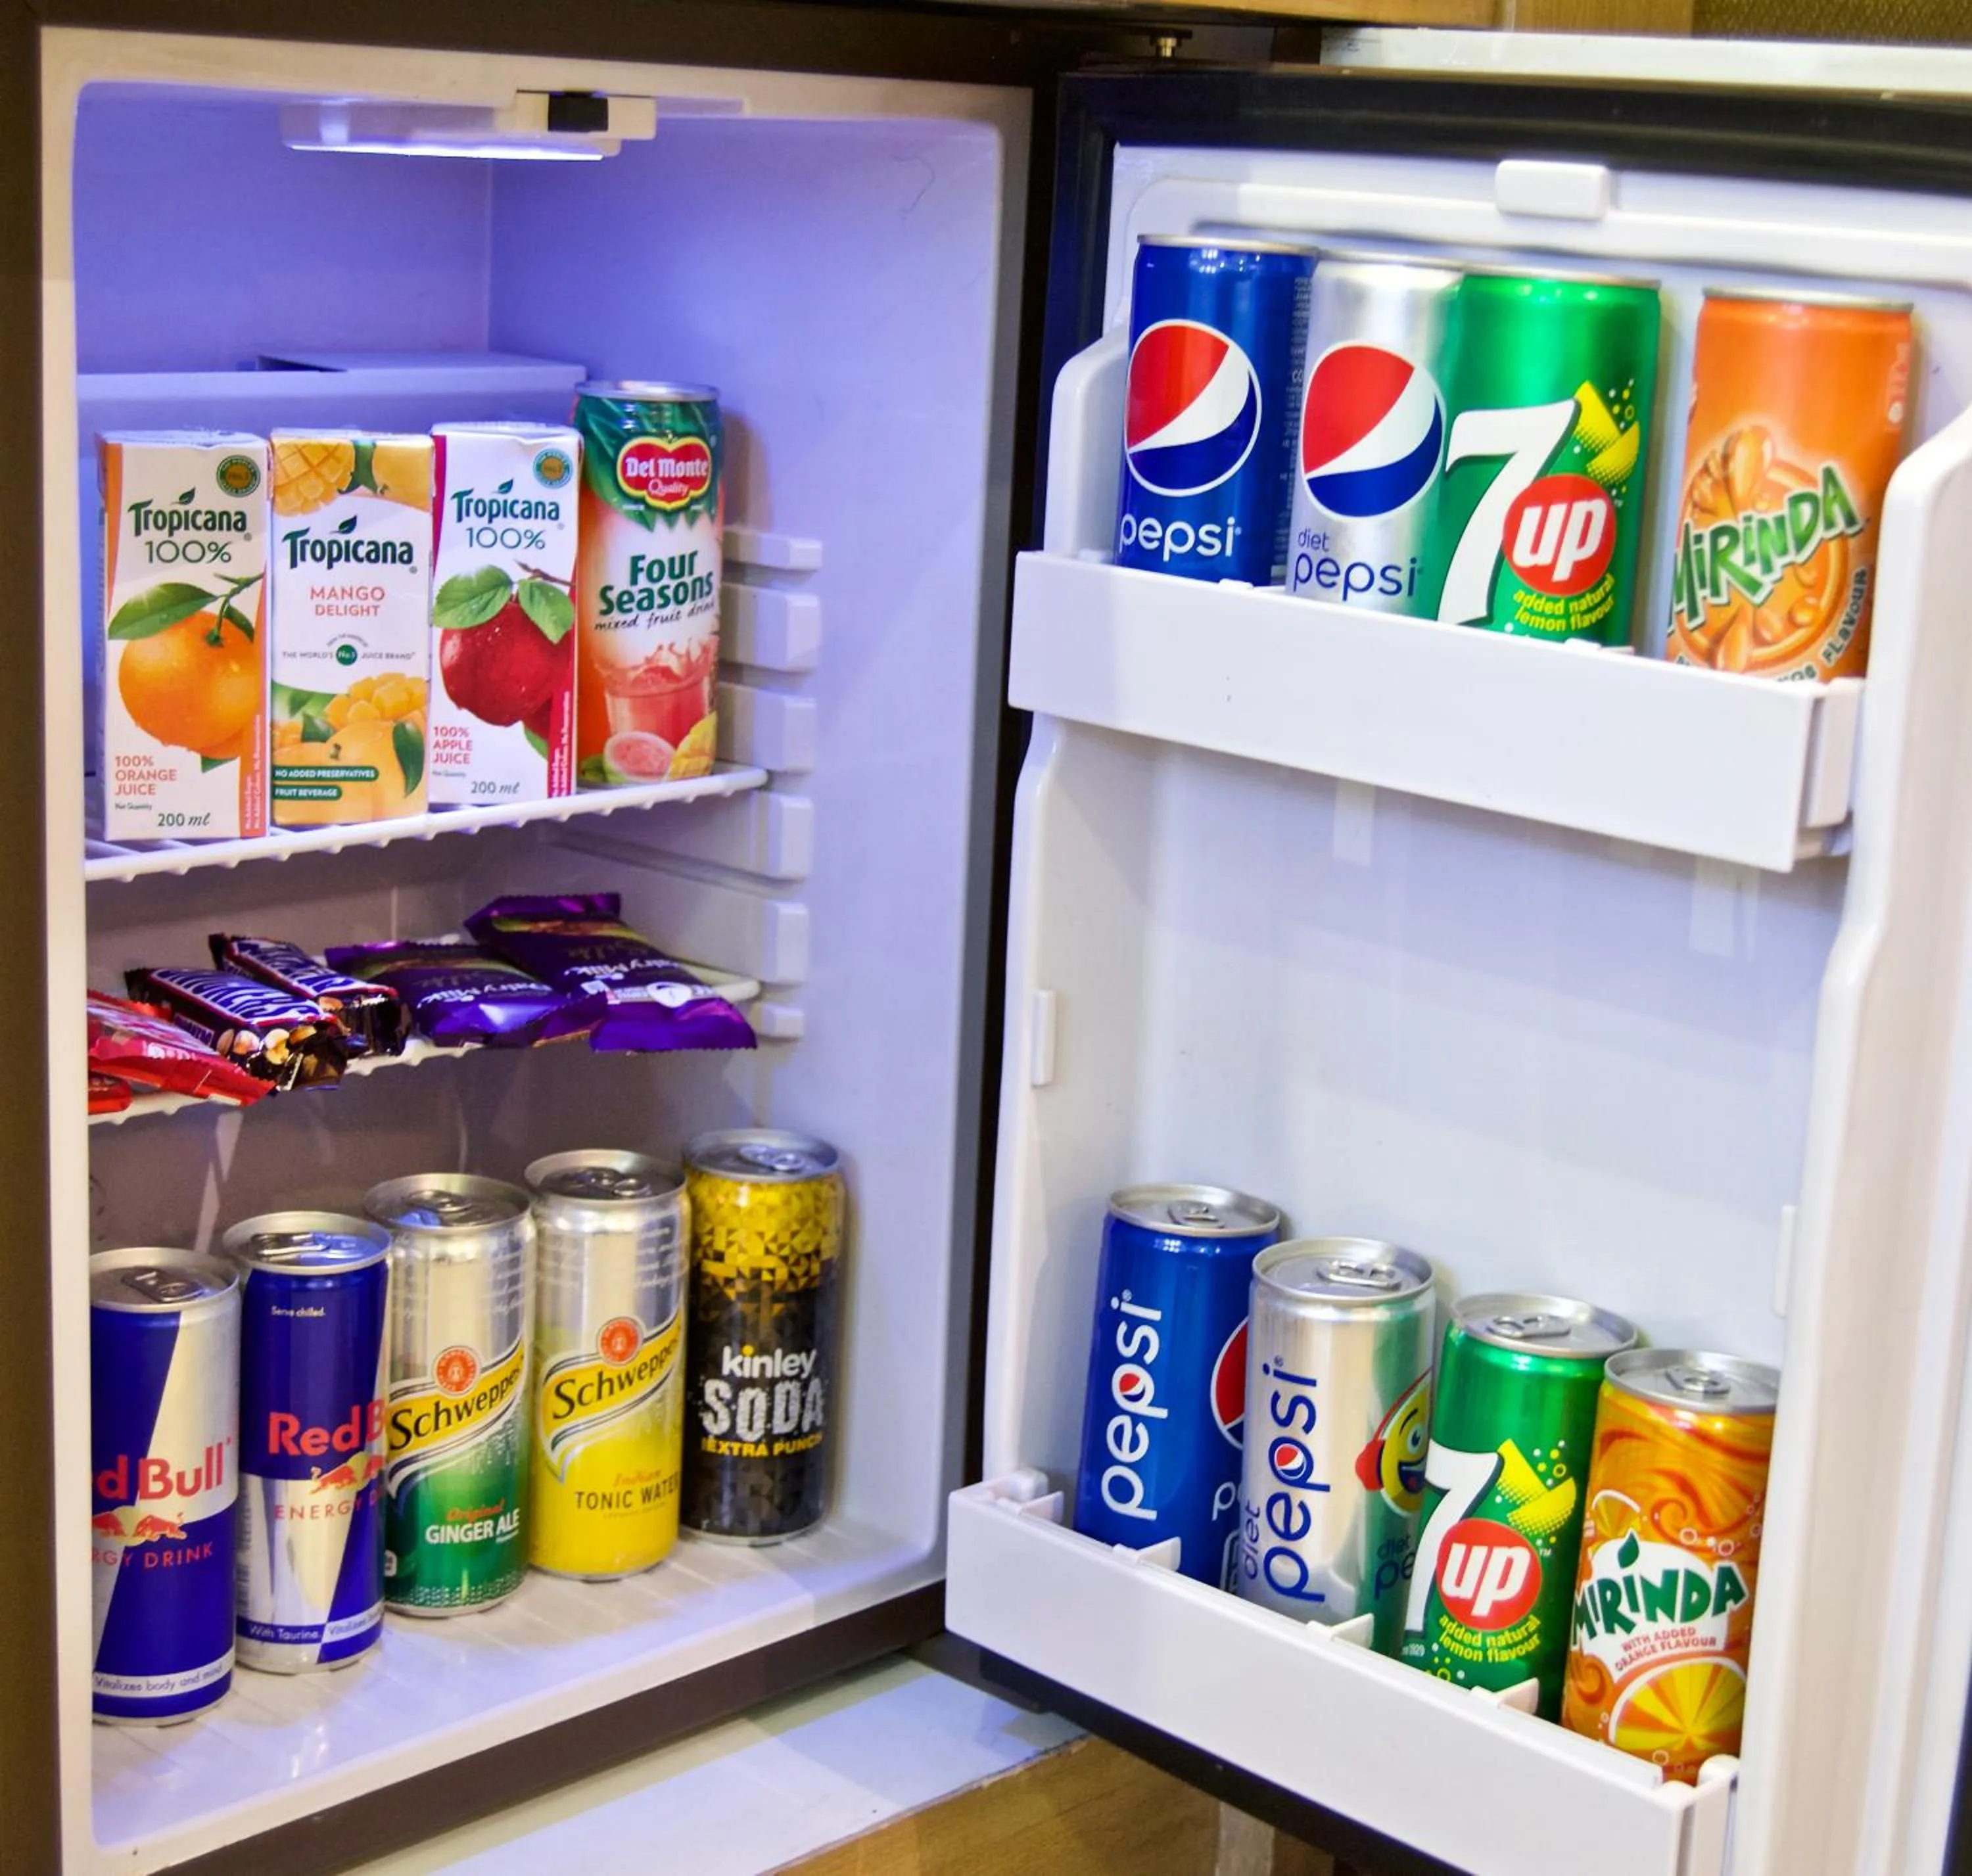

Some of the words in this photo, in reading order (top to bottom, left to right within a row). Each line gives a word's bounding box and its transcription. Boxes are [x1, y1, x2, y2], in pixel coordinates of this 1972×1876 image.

[626, 457, 656, 477] Del
[657, 457, 709, 477] Monte
[648, 479, 690, 496] Quality
[128, 498, 247, 537] Tropicana
[450, 488, 559, 524] Tropicana
[282, 527, 413, 570] Tropicana
[466, 527, 546, 550] 100%
[1119, 513, 1235, 562] pepsi
[1298, 527, 1329, 552] diet
[145, 540, 233, 563] 100%
[630, 550, 698, 586] Four
[1293, 553, 1417, 601] pepsi
[310, 586, 385, 601] MANGO
[599, 571, 713, 616] Seasons
[1513, 589, 1564, 615] added
[1569, 573, 1615, 613] natural
[316, 604, 380, 617] DELIGHT
[594, 614, 639, 631] mixed
[647, 610, 682, 630] fruit
[1514, 605, 1566, 632] lemon
[1570, 595, 1614, 630] flavour
[433, 726, 469, 738] 100%
[433, 739, 473, 751] APPLE
[116, 756, 153, 767] 100%
[433, 753, 471, 764] JUICE
[115, 770, 177, 781] ORANGE
[275, 769, 287, 778] NO
[289, 769, 316, 778] ADDED
[317, 770, 375, 778] PRESERVATIVES
[115, 784, 156, 795] JUICE
[275, 788, 297, 797] FRUIT
[471, 781, 496, 794] 200
[157, 813, 185, 826] 200
[187, 812, 210, 826] ml
[722, 1345, 817, 1379] kinley
[1101, 1296, 1169, 1522] pepsi
[268, 1404, 361, 1456] Red
[139, 1442, 223, 1500] Bull
[1263, 1363, 1331, 1603] pepsi
[273, 1496, 361, 1520] ENERGY
[575, 1490, 633, 1510] TONIC
[425, 1520, 495, 1544] GINGER
[496, 1508, 520, 1536] ALE
[1242, 1499, 1260, 1580] diet
[144, 1541, 213, 1568] DRINK
[250, 1624, 273, 1638] With
[1440, 1614, 1482, 1647] added
[1486, 1614, 1540, 1648] natural
[1622, 1633, 1650, 1652] WITH
[1654, 1626, 1696, 1641] ADDED
[1440, 1631, 1483, 1662] lemon
[1488, 1633, 1540, 1663] flavour
[1615, 1645, 1658, 1671] ORANGE
[1662, 1636, 1716, 1651] FLAVOUR
[146, 1679, 176, 1692] body
[180, 1673, 199, 1687] and
